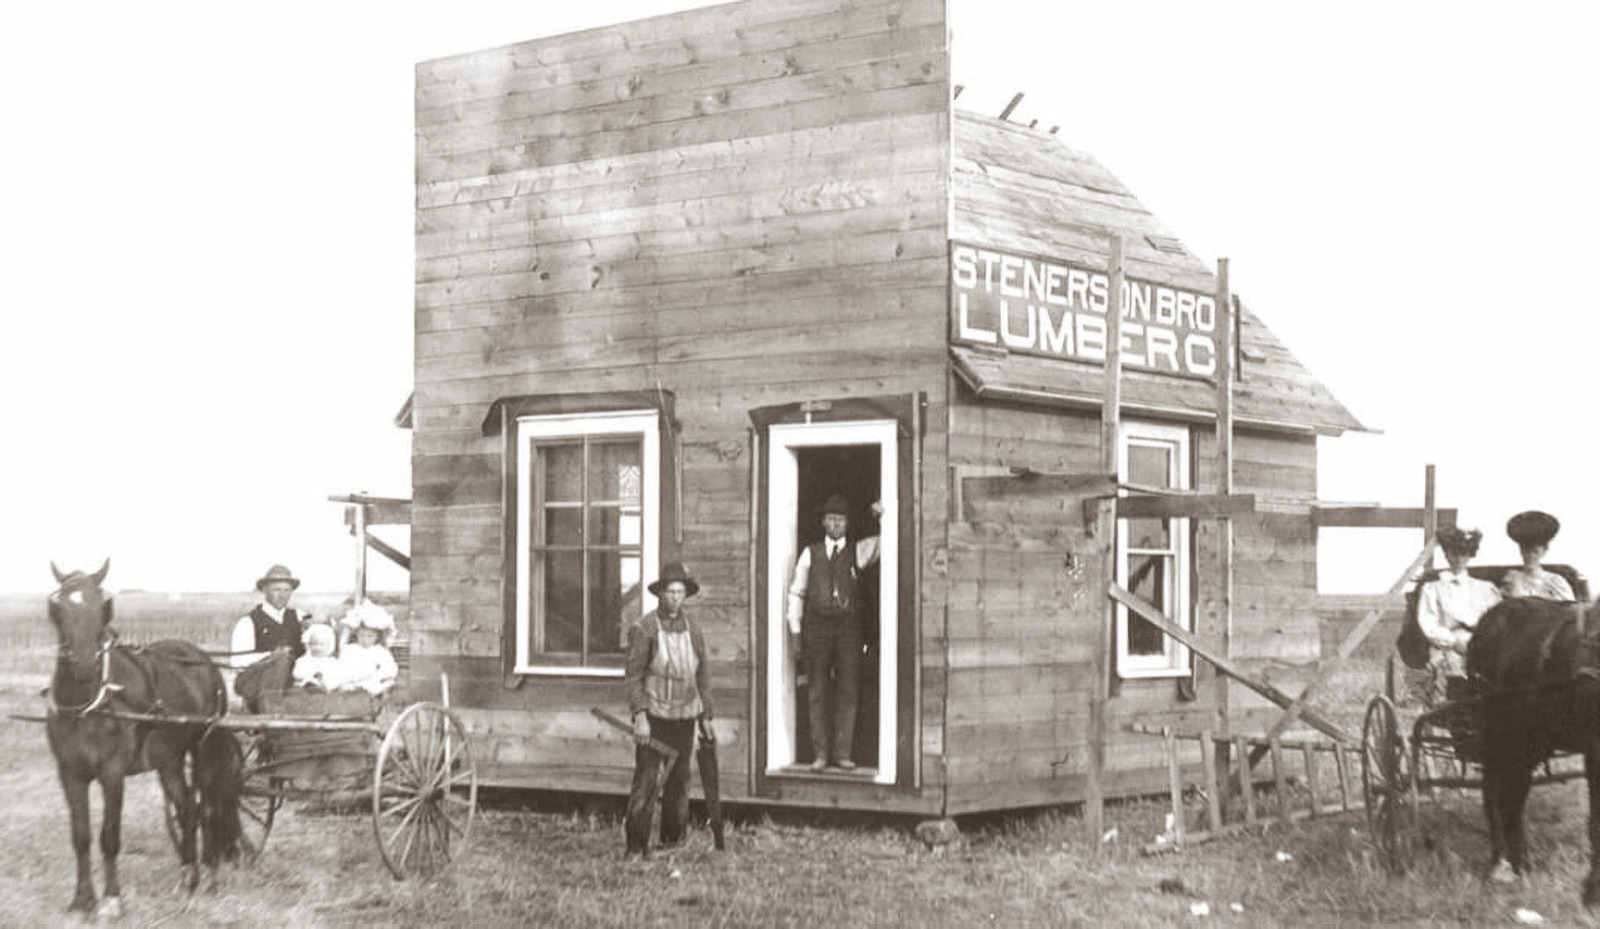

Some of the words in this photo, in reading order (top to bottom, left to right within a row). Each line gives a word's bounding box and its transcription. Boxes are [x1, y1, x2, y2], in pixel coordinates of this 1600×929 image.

[960, 293, 1179, 372] LUMBER
[1184, 333, 1234, 376] C
[1156, 287, 1235, 334] BRO
